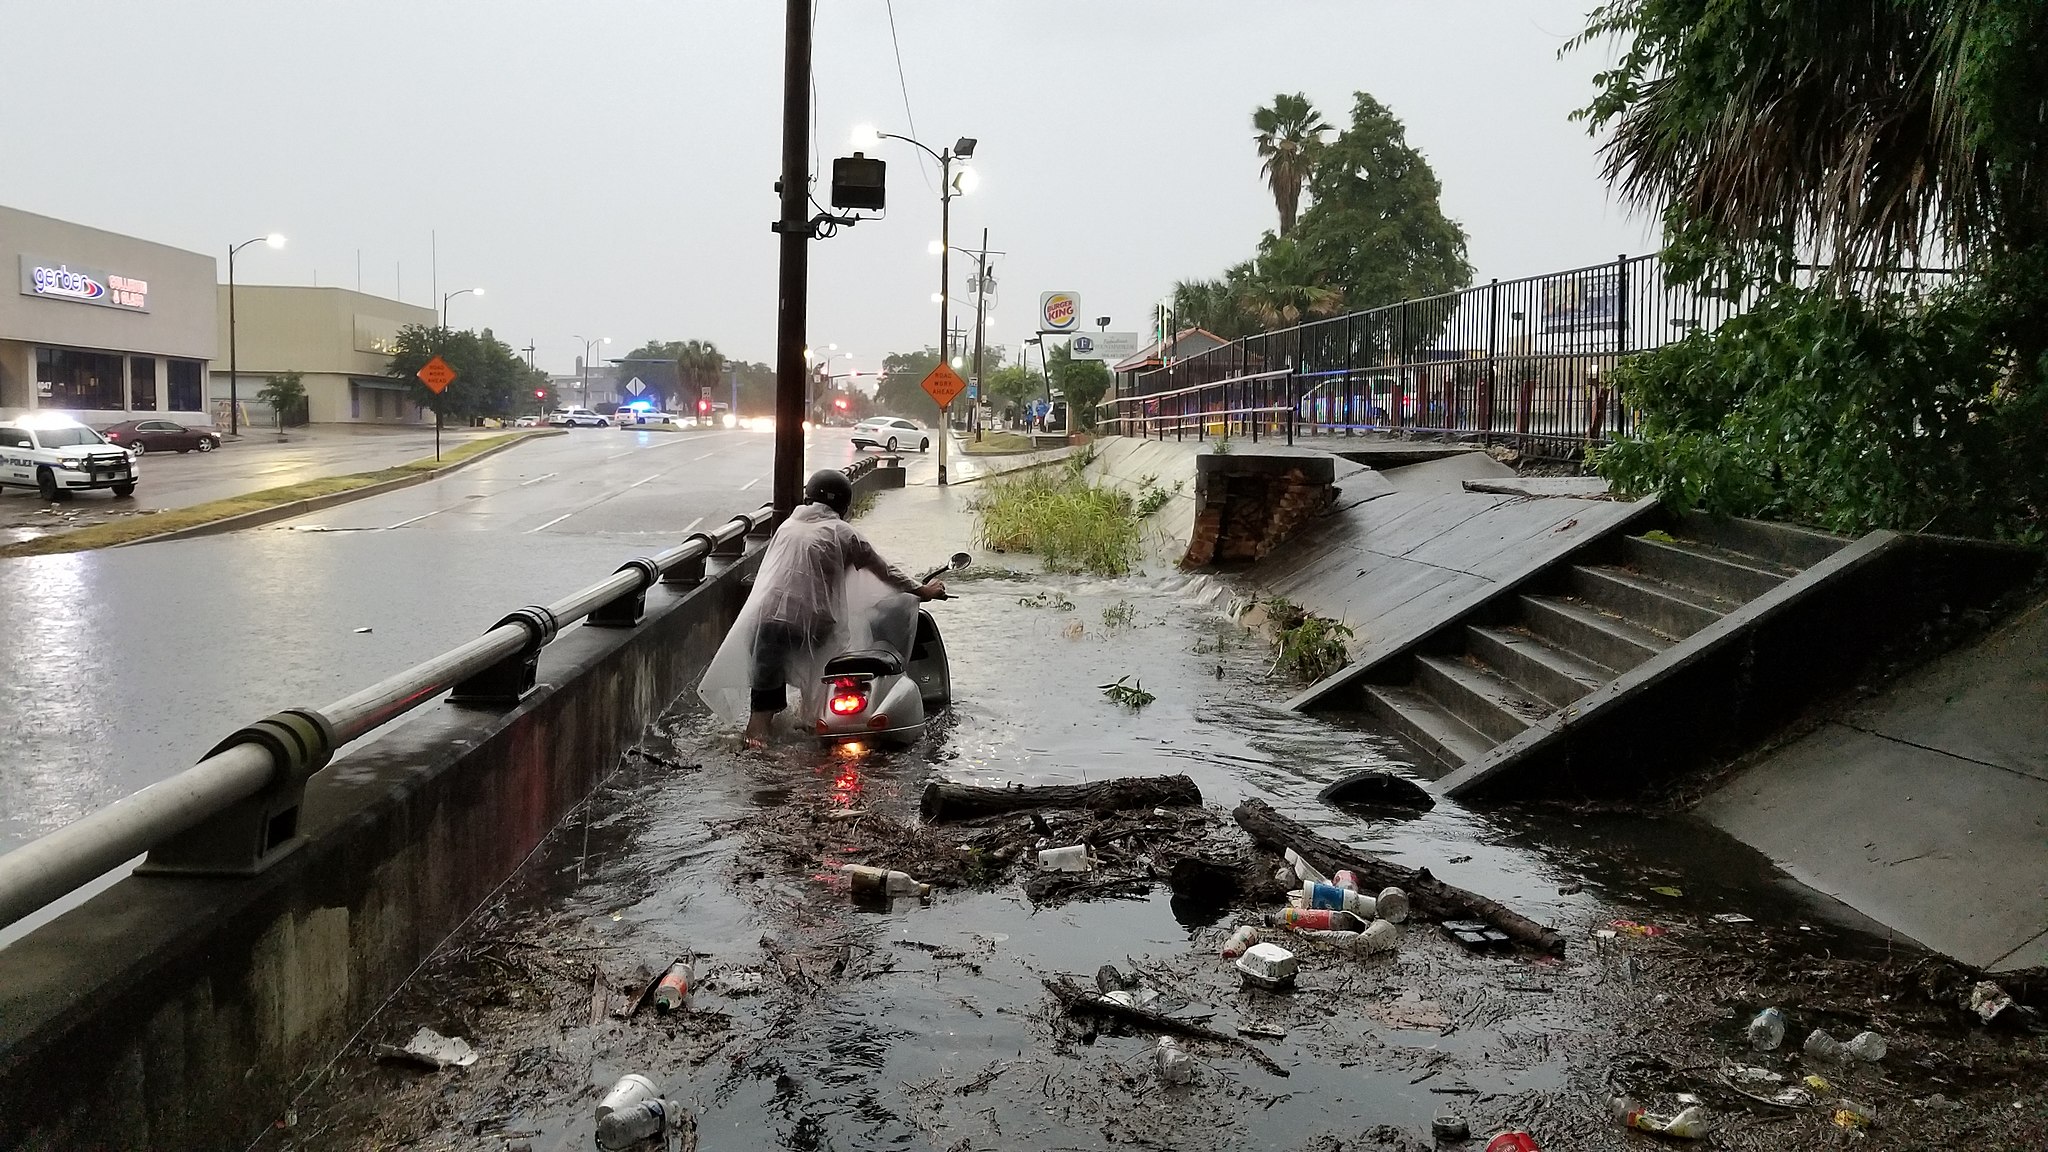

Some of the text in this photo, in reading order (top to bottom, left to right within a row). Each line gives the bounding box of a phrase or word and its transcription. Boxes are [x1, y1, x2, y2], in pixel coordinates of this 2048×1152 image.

[34, 265, 88, 293] gerber
[1047, 300, 1073, 312] BURGER
[1048, 306, 1074, 320] KING
[9, 458, 33, 467] POLICE
